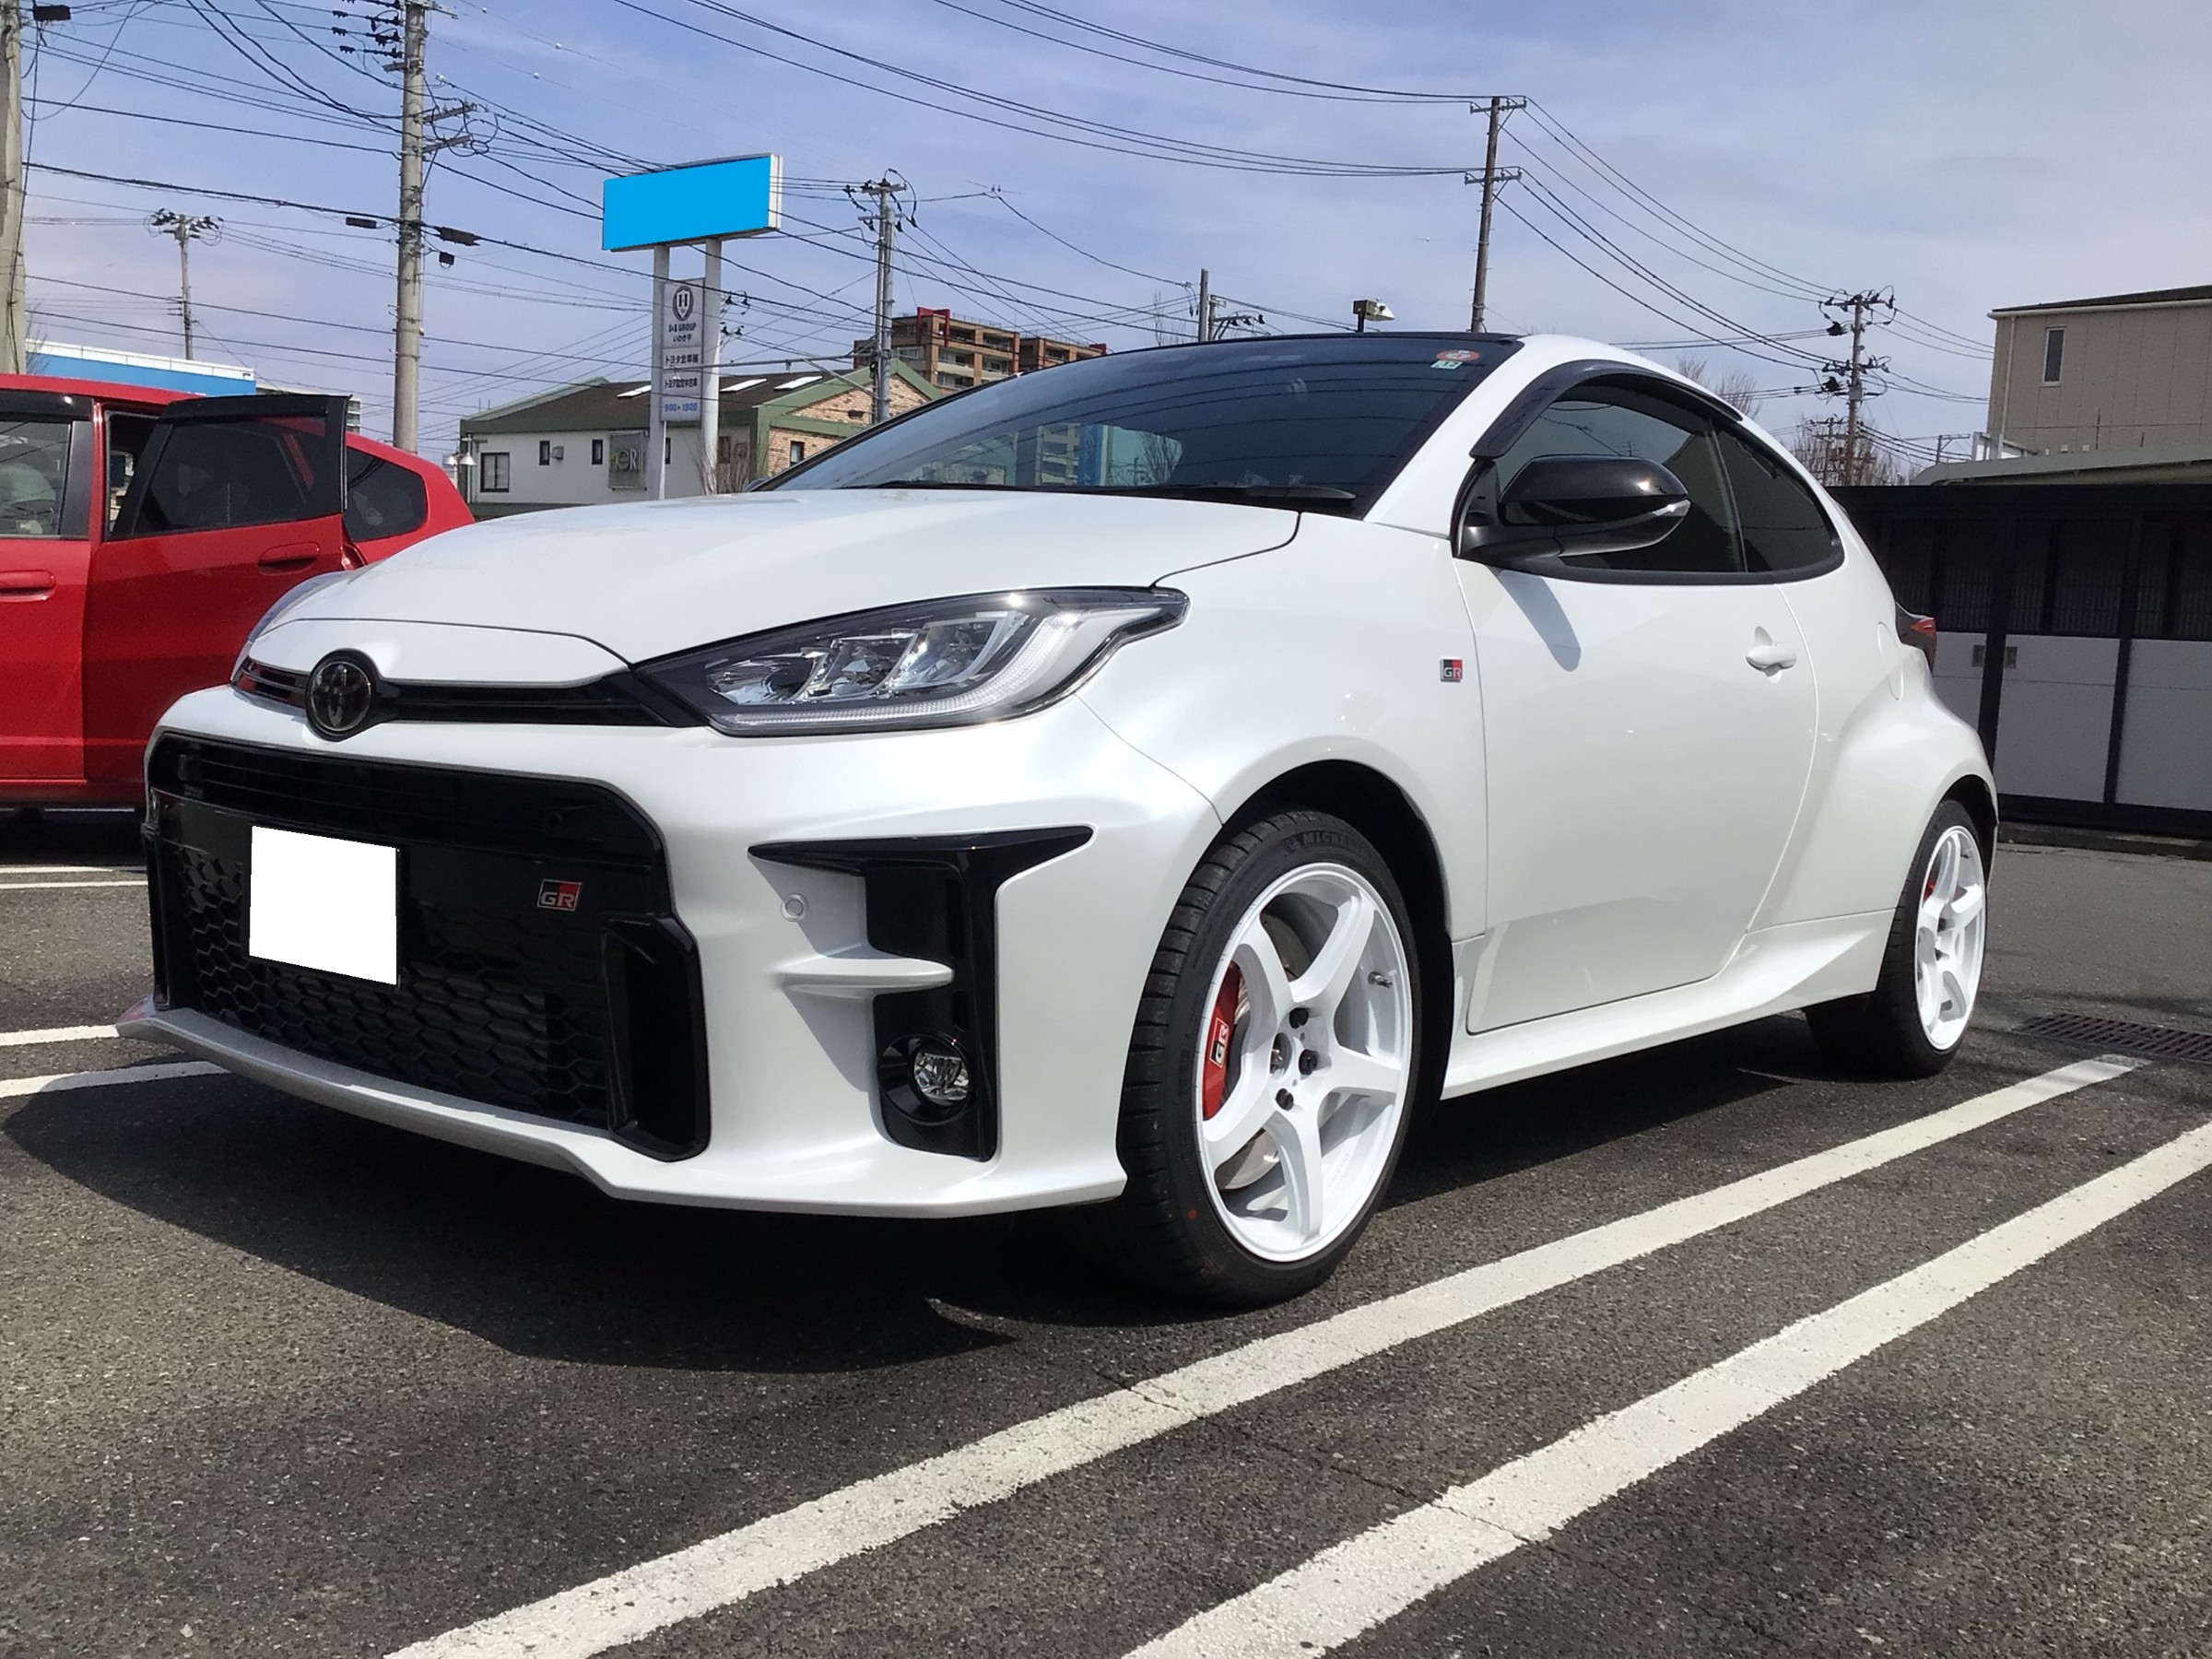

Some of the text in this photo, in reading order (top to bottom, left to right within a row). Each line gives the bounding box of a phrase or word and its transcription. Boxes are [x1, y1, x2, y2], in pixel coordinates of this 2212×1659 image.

[1443, 666, 1462, 677] GR
[540, 891, 574, 908] GR
[1216, 1024, 1230, 1065] GR
